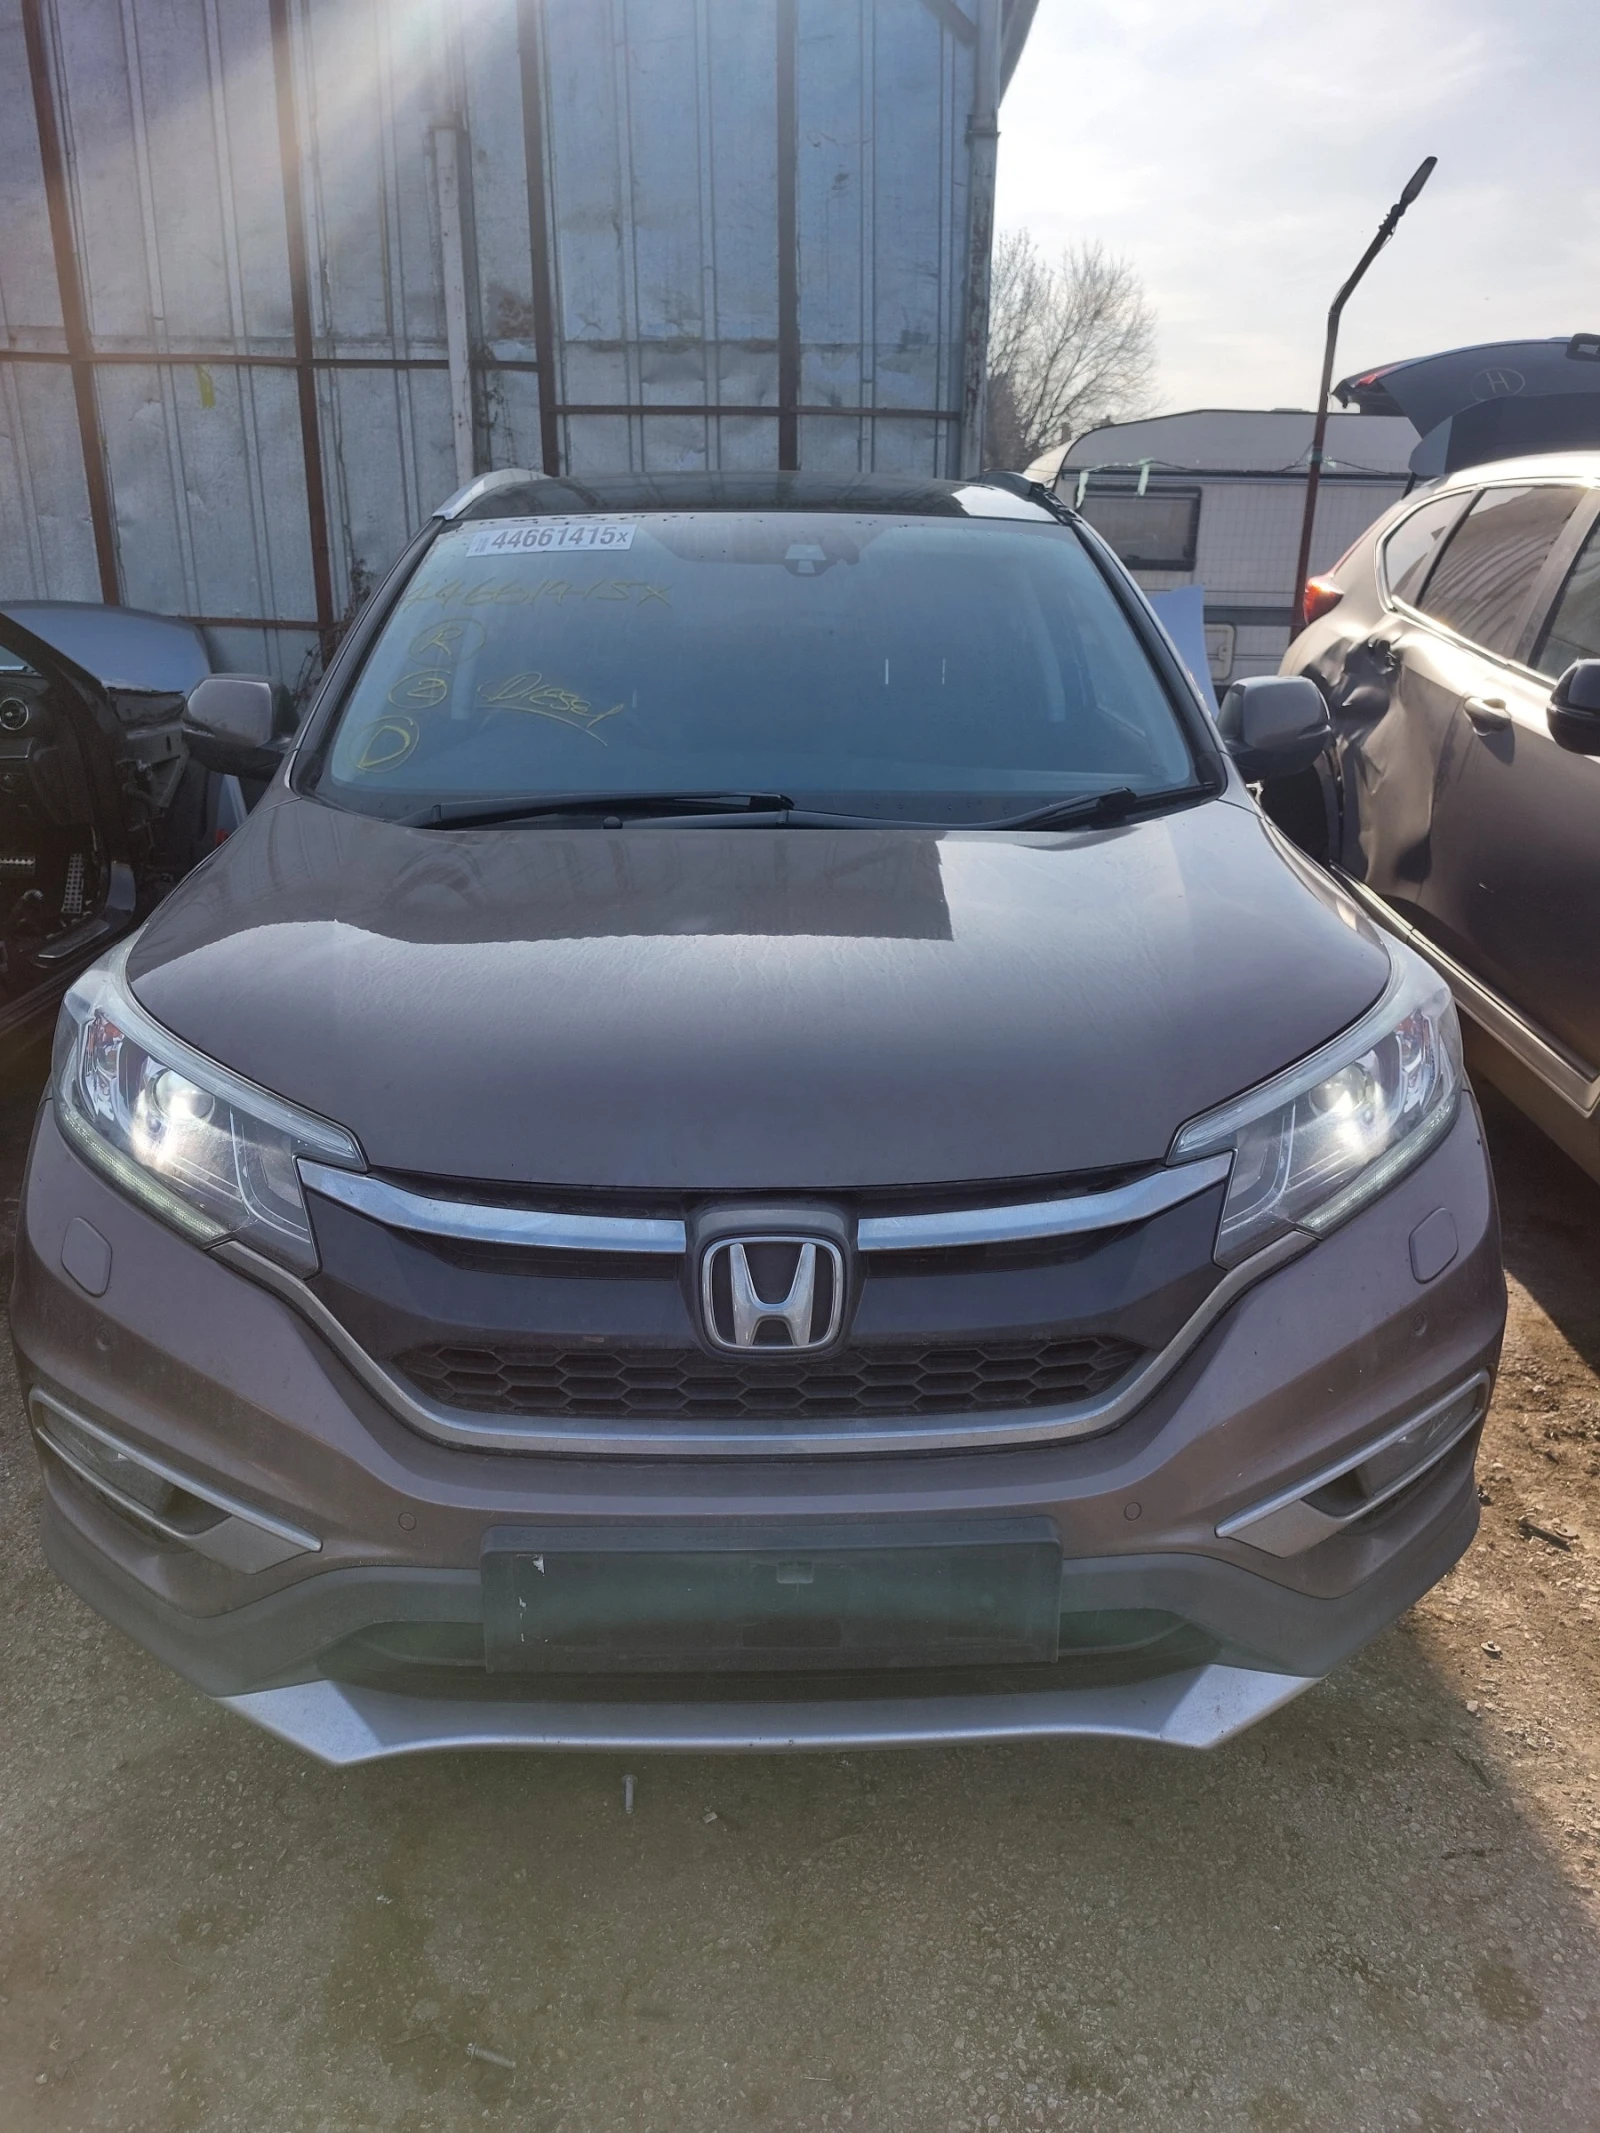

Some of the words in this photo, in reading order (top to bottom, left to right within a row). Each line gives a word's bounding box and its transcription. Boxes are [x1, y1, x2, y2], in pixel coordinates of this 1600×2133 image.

[1486, 371, 1512, 394] H
[420, 622, 465, 656] R
[357, 725, 411, 769] D
